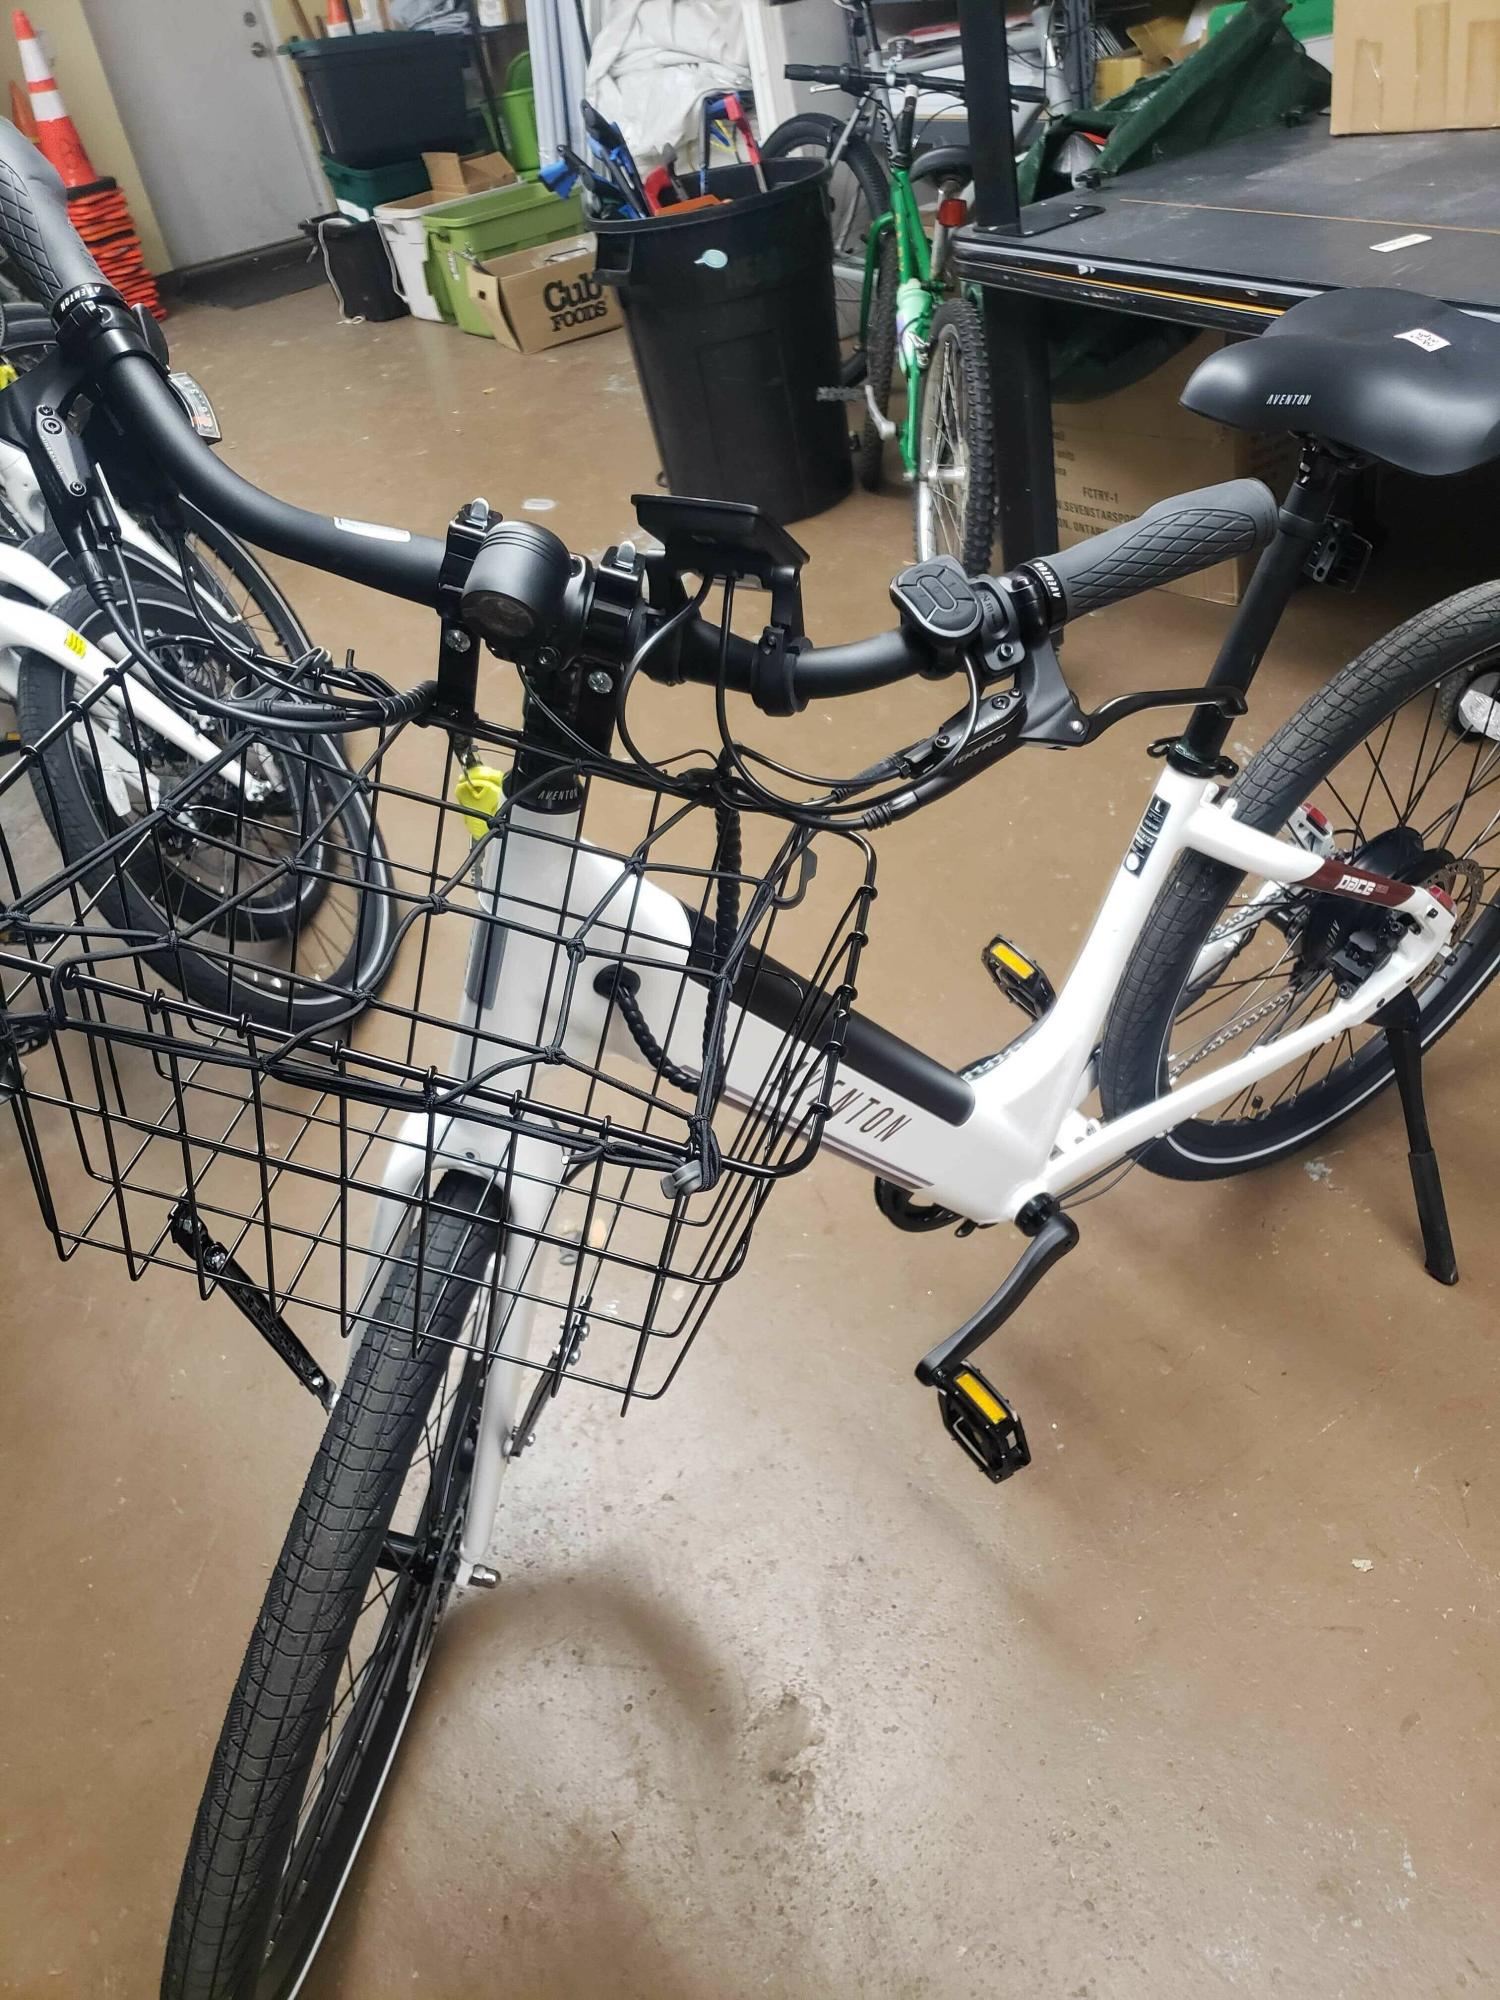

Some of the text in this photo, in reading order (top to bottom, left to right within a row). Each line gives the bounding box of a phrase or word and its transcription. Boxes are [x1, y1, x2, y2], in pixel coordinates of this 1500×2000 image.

[543, 273, 603, 312] Cub
[1266, 394, 1312, 406] AVENTON
[1082, 486, 1119, 504] FCTRY-1
[1033, 562, 1062, 598] AVENTON
[537, 789, 579, 801] AVENTON
[769, 1061, 913, 1143] VNTON
